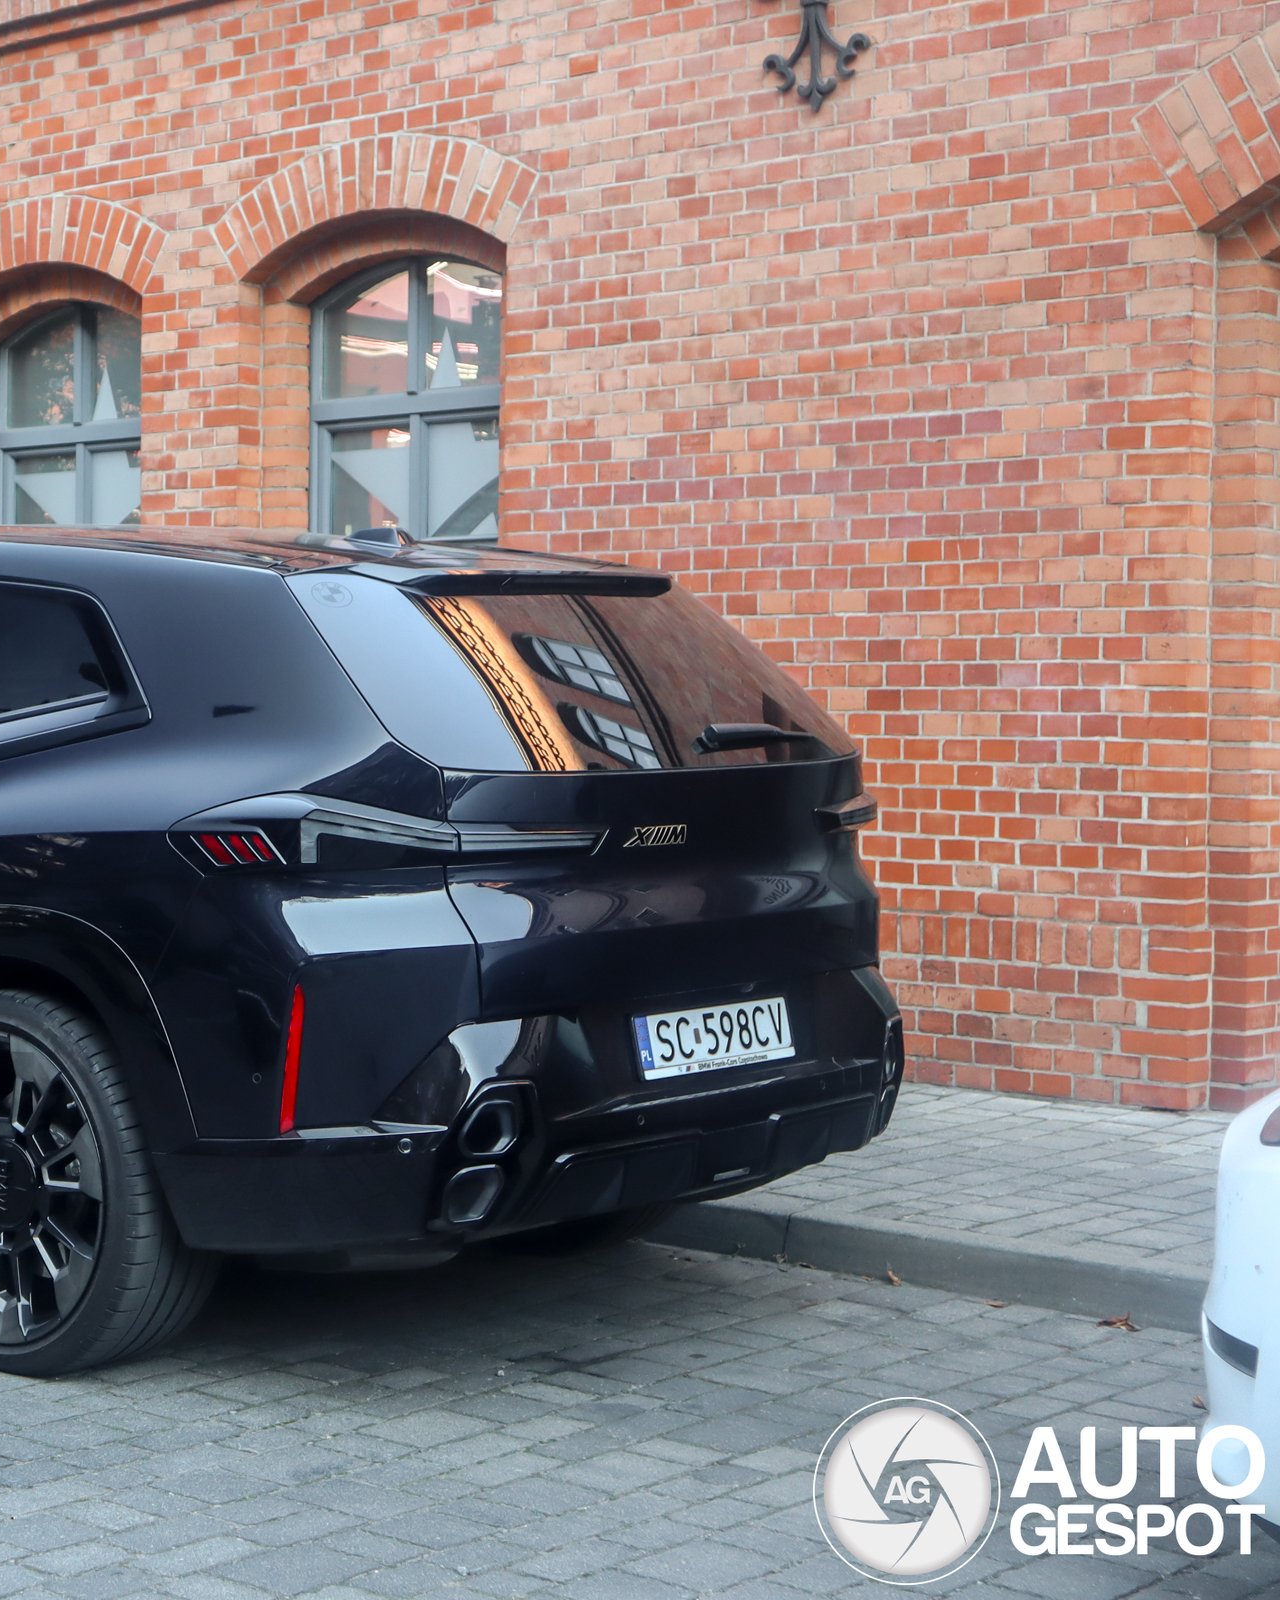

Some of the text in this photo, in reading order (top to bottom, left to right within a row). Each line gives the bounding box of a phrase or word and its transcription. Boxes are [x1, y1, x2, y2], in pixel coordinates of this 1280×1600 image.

[656, 1003, 783, 1062] SC 598CV
[641, 1050, 652, 1062] PL
[698, 1063, 711, 1071] BMW
